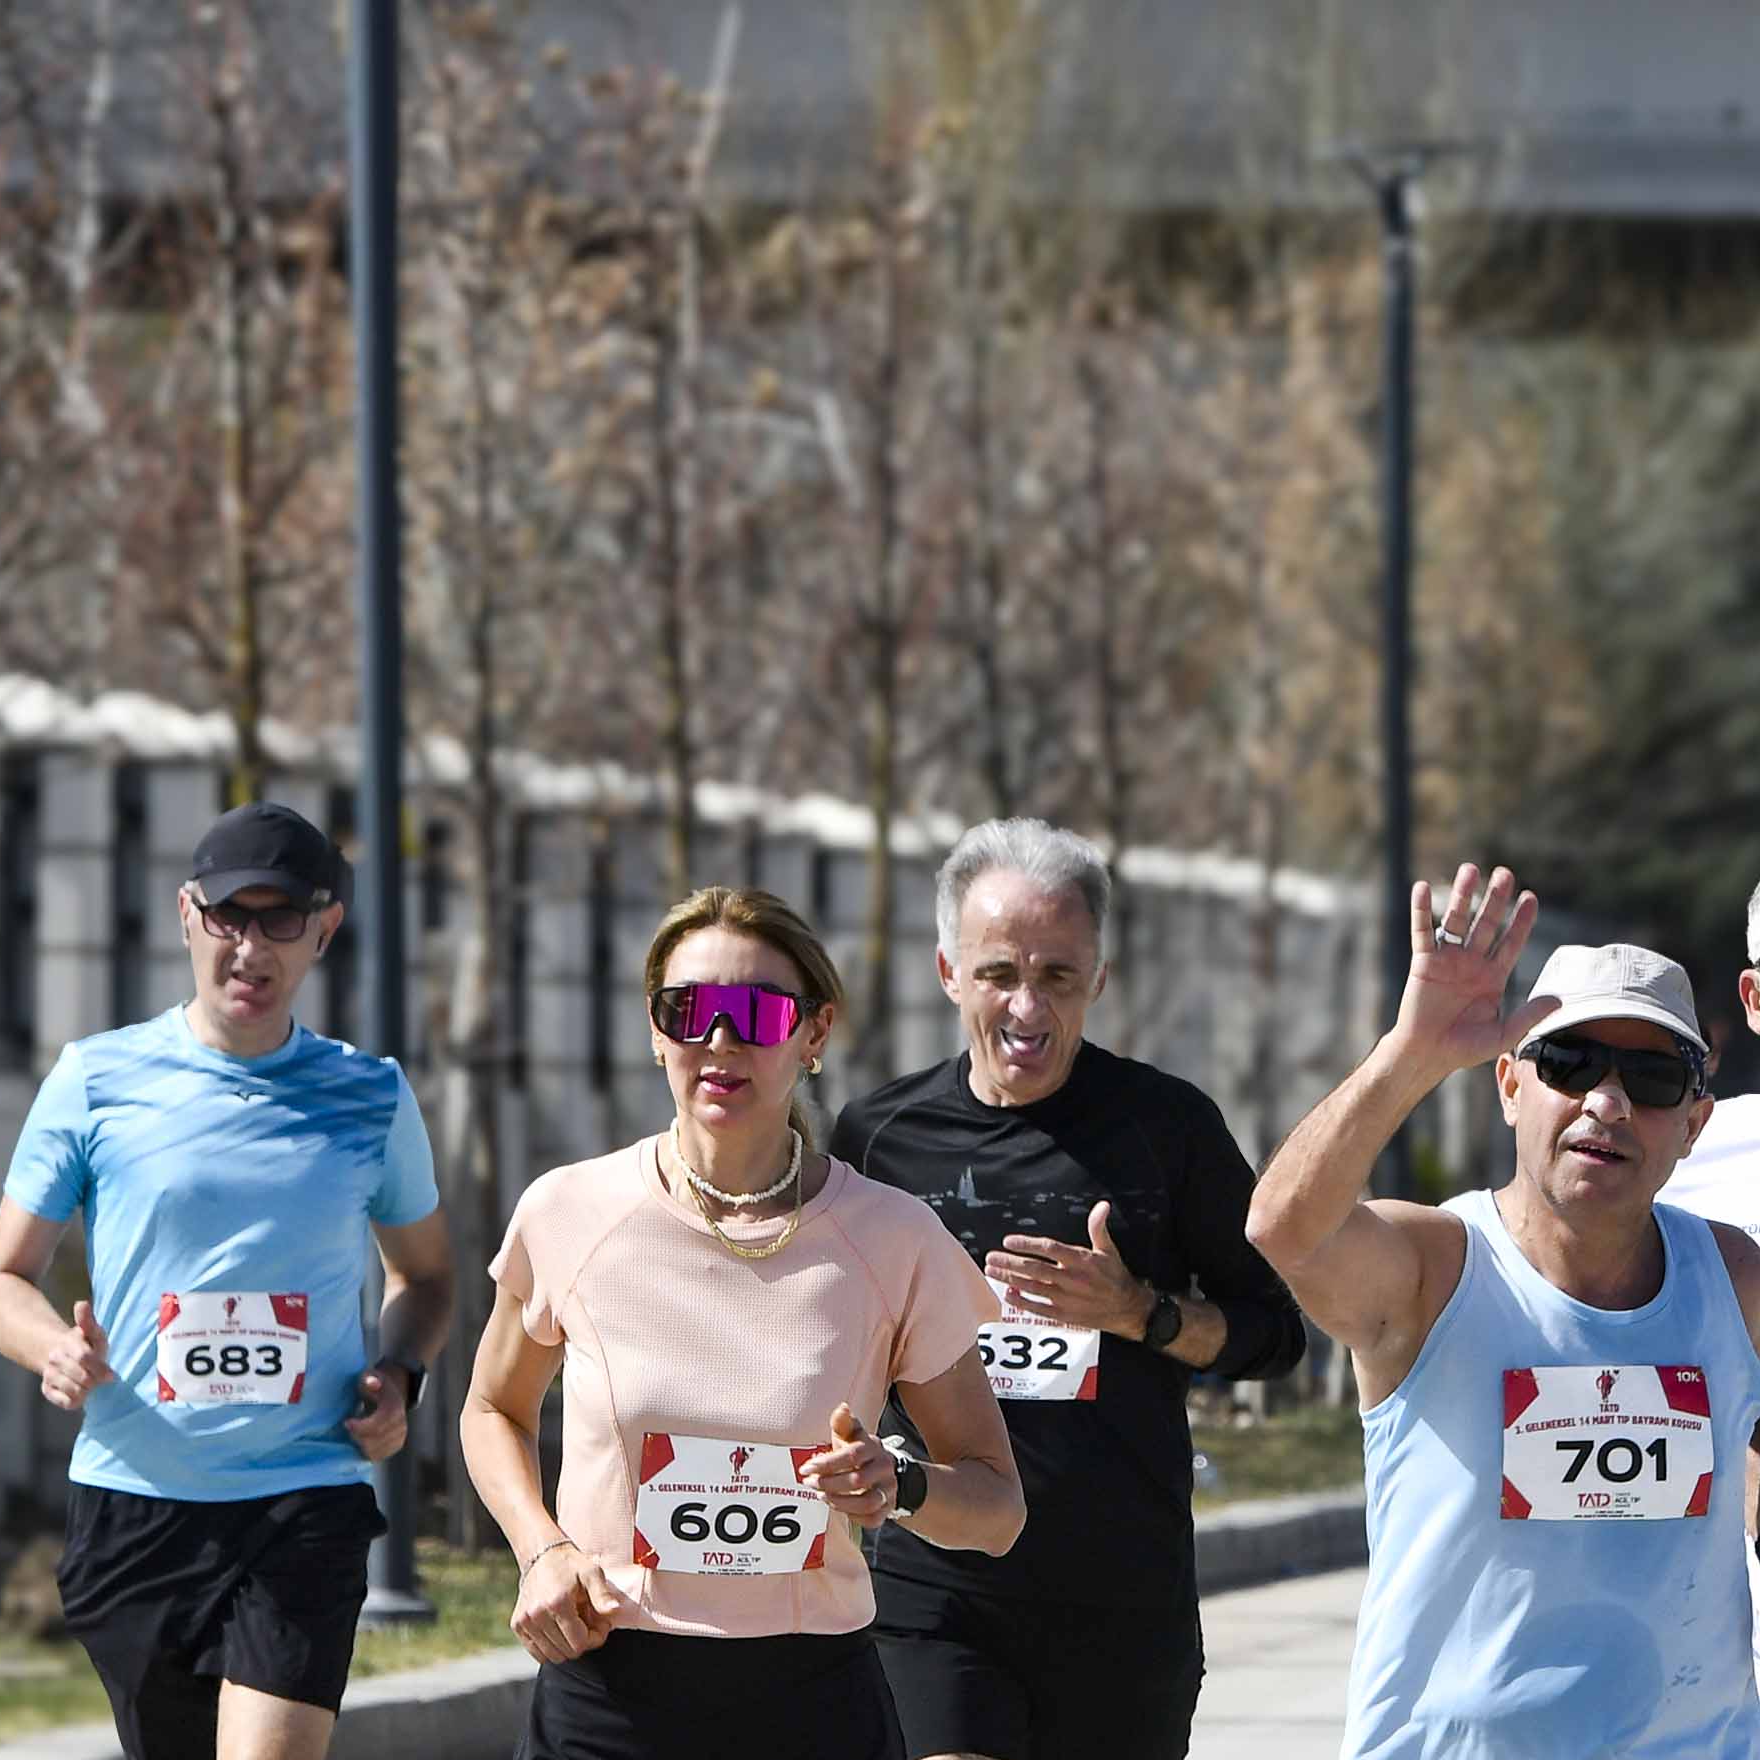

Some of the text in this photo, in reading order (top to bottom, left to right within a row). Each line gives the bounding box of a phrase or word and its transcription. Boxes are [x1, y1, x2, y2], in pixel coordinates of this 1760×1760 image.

[185, 1345, 283, 1377] 683
[1677, 1371, 1700, 1382] 10K
[1592, 1415, 1615, 1425] MART
[1617, 1415, 1630, 1425] TIP
[1632, 1415, 1669, 1427] BAYRAMI
[1556, 1438, 1667, 1483] 701
[721, 1485, 743, 1494] MART
[745, 1485, 757, 1494] TIP
[759, 1486, 795, 1497] BAYRAMI
[1577, 1493, 1611, 1508] TATD
[670, 1502, 801, 1544] 606
[703, 1552, 733, 1565] TATD
